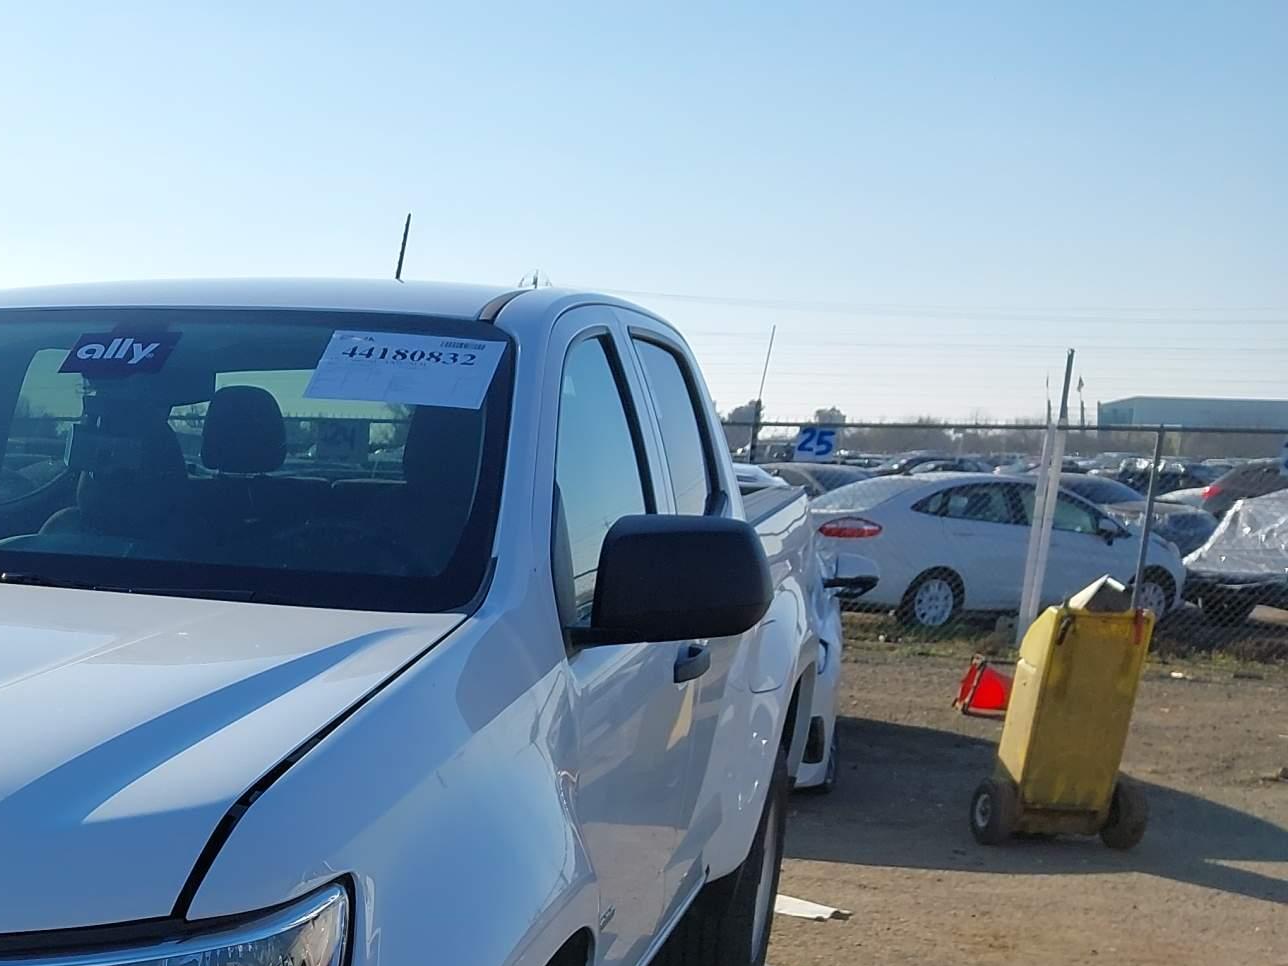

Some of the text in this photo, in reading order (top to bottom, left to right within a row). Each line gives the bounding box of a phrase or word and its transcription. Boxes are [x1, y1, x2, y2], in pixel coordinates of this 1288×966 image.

[77, 338, 160, 364] ally
[342, 346, 477, 366] 44180832
[797, 427, 836, 456] 25
